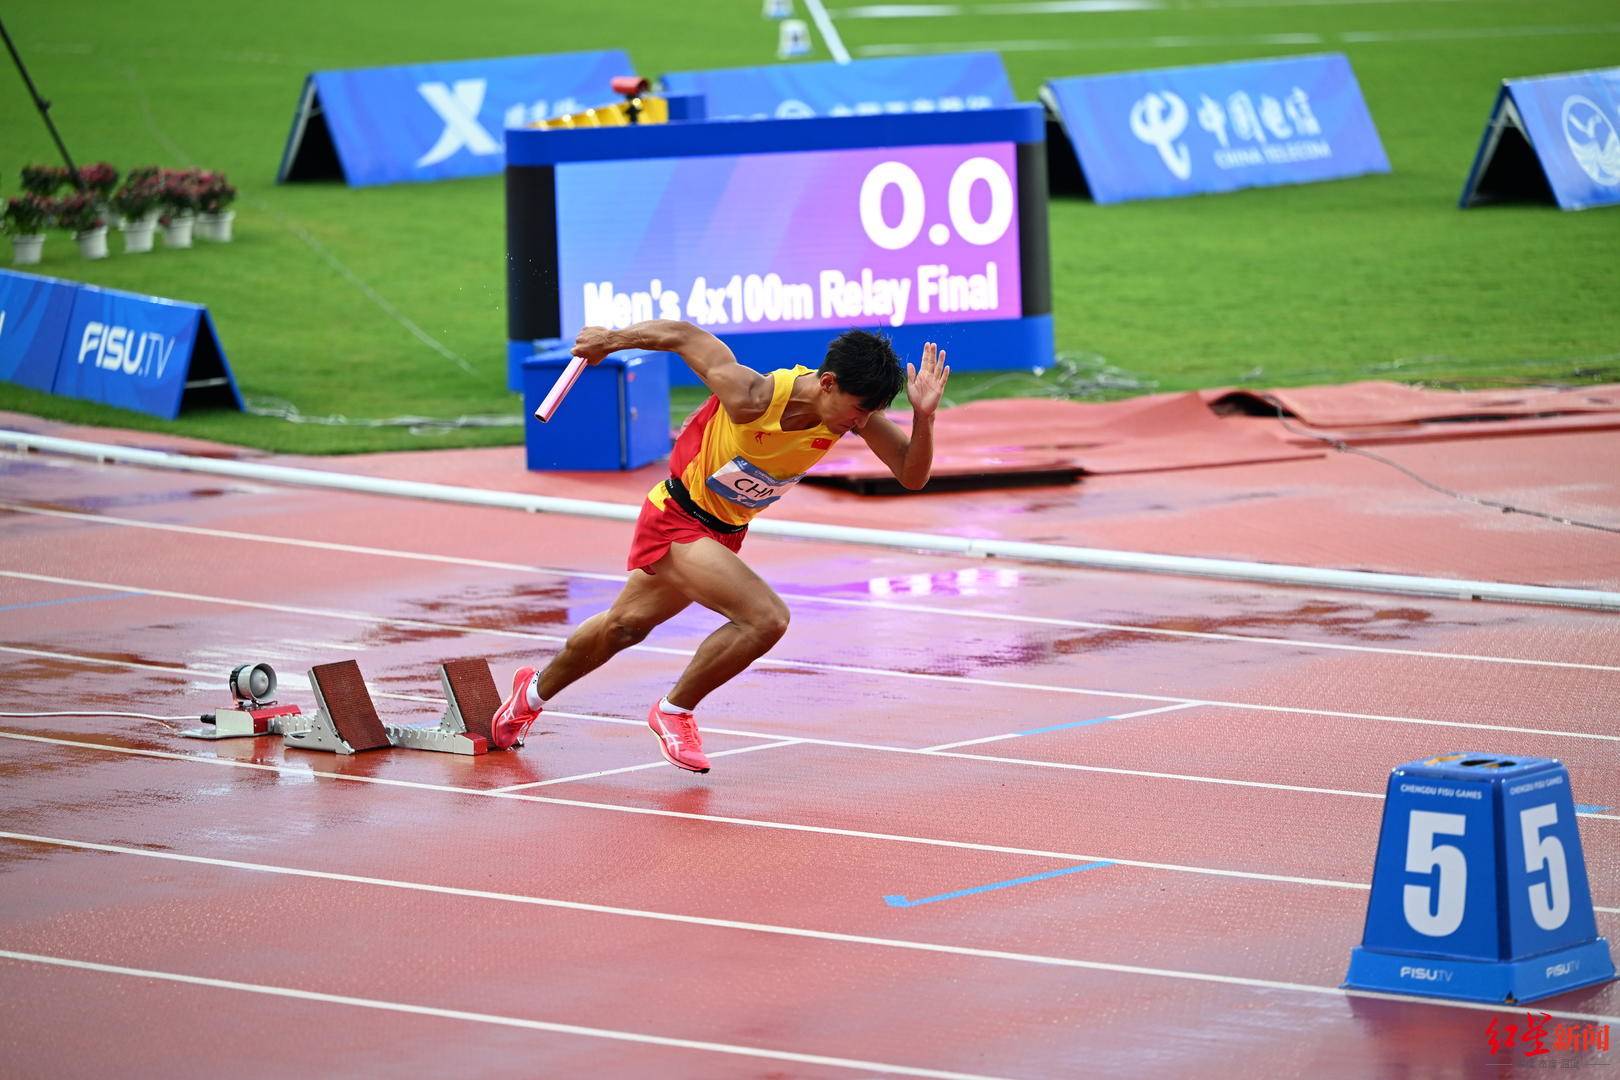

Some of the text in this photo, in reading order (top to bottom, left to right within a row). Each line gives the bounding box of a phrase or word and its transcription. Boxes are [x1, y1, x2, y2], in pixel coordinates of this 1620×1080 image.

[859, 156, 1014, 250] 0.0
[584, 261, 999, 330] Men's 4x100m Relay Final
[1400, 783, 1483, 801] CHENGDU FISU GAMES
[1402, 809, 1468, 938] 5
[1519, 802, 1571, 931] 5
